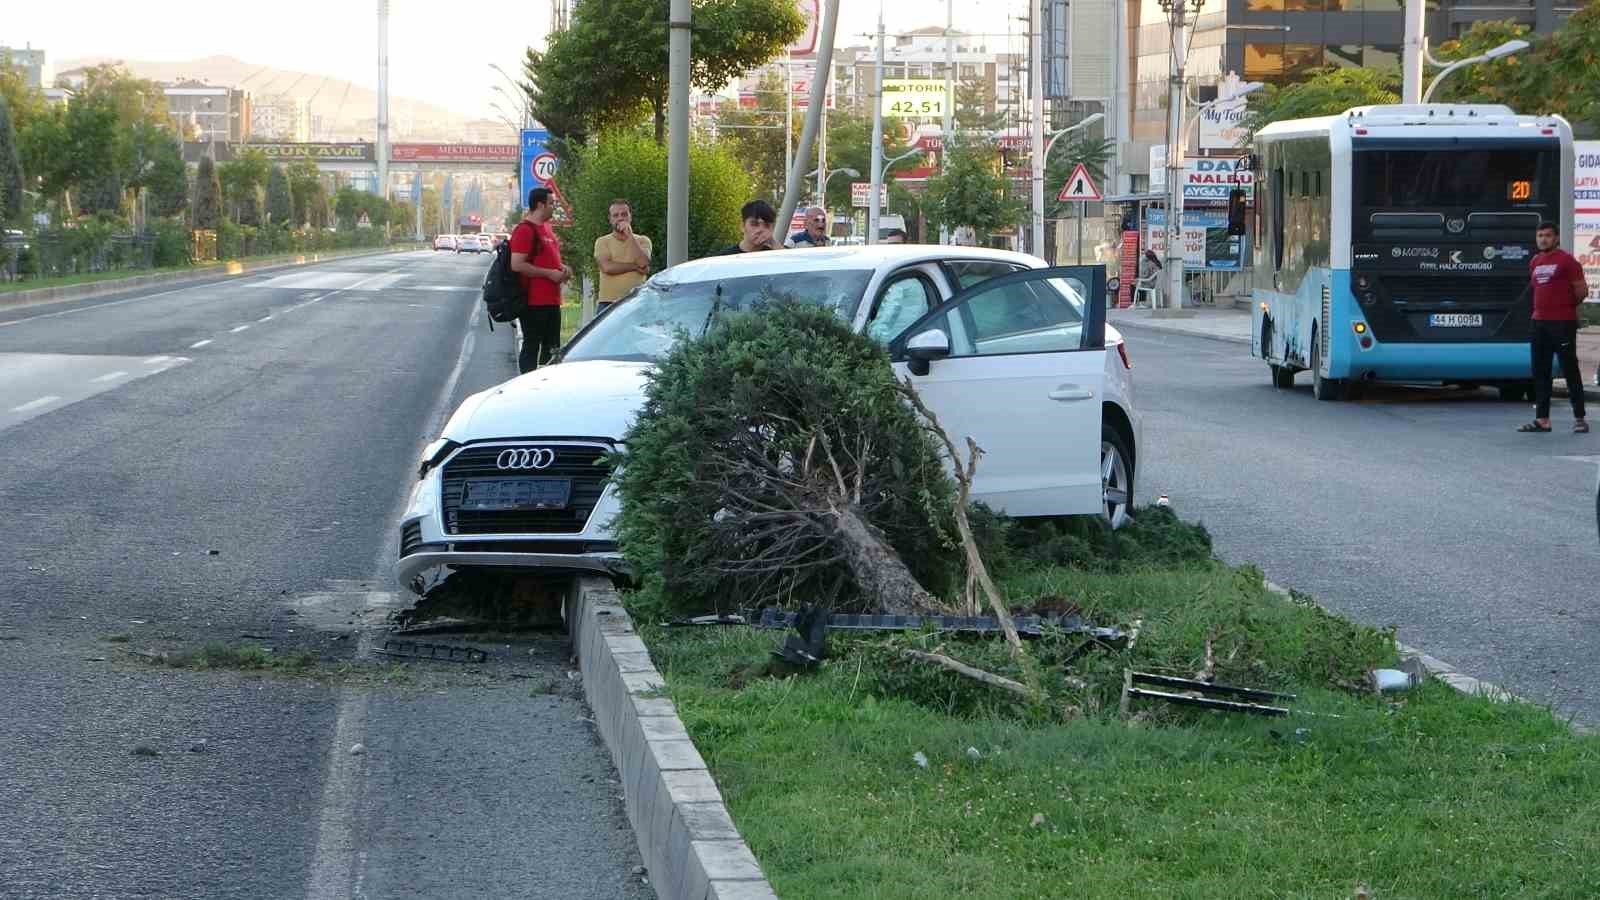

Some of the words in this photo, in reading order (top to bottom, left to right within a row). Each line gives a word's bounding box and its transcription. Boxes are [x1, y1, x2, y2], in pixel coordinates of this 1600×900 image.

[891, 101, 941, 114] 42,51
[318, 147, 361, 156] AVM
[539, 162, 554, 175] 70
[1185, 187, 1226, 196] AYGAZ
